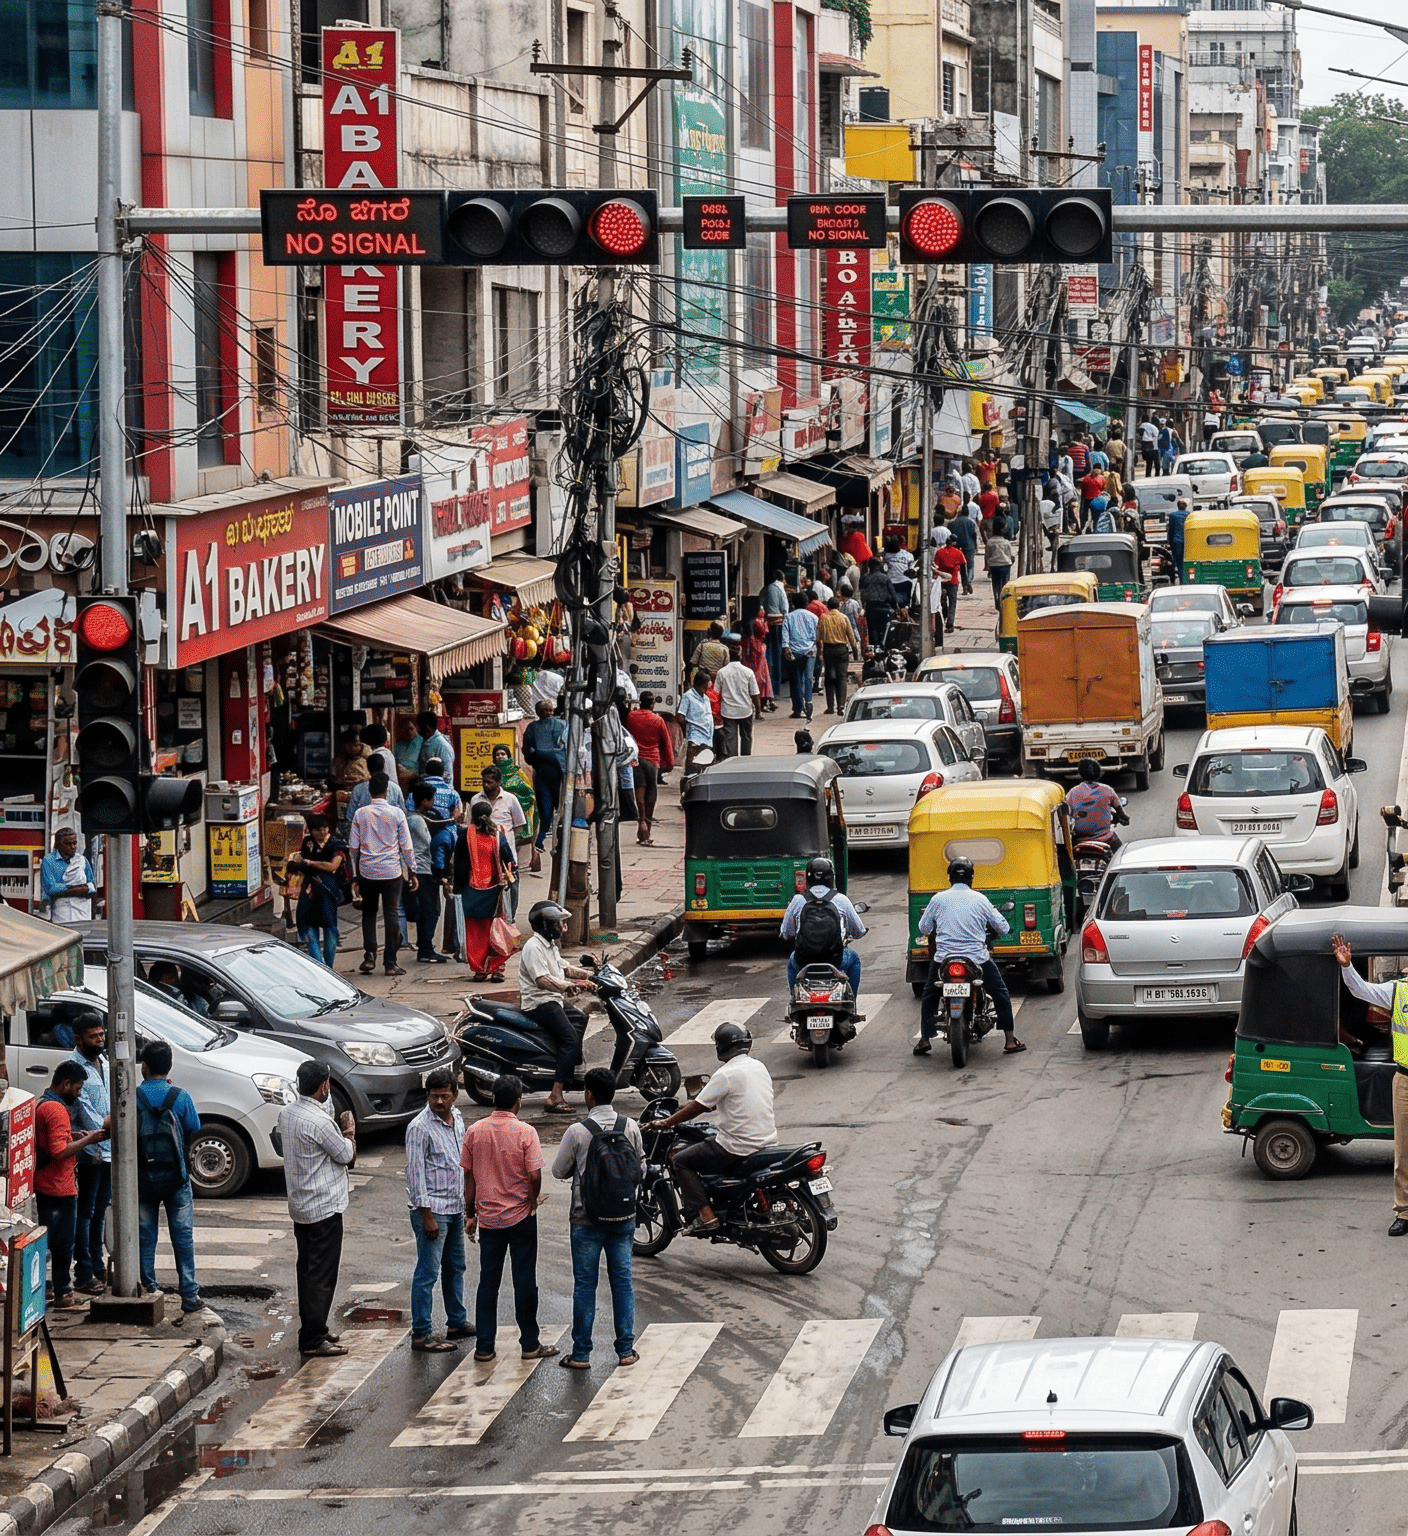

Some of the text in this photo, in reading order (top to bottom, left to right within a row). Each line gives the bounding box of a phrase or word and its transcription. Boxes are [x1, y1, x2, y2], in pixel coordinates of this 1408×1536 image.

[329, 83, 389, 115] A1
[286, 232, 426, 255] NO SIGNAL
[808, 230, 826, 241] NO
[335, 497, 382, 546] MOBILE
[384, 489, 419, 534] POINT
[181, 541, 220, 642] A1
[228, 543, 326, 627] BAKERY
